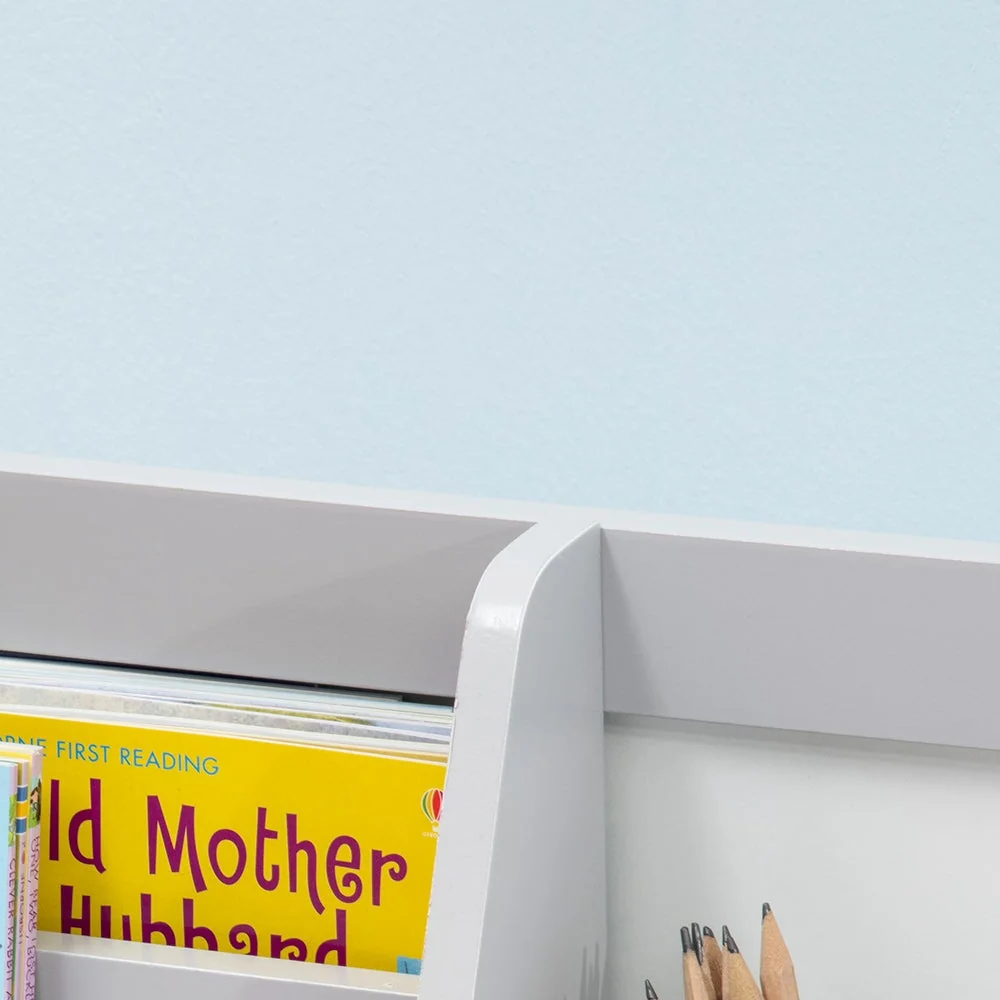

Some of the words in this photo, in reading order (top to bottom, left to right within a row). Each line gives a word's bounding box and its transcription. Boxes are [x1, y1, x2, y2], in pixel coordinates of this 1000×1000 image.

[56, 741, 110, 763] FIRST
[120, 748, 219, 775] READING
[148, 796, 407, 914] Mother
